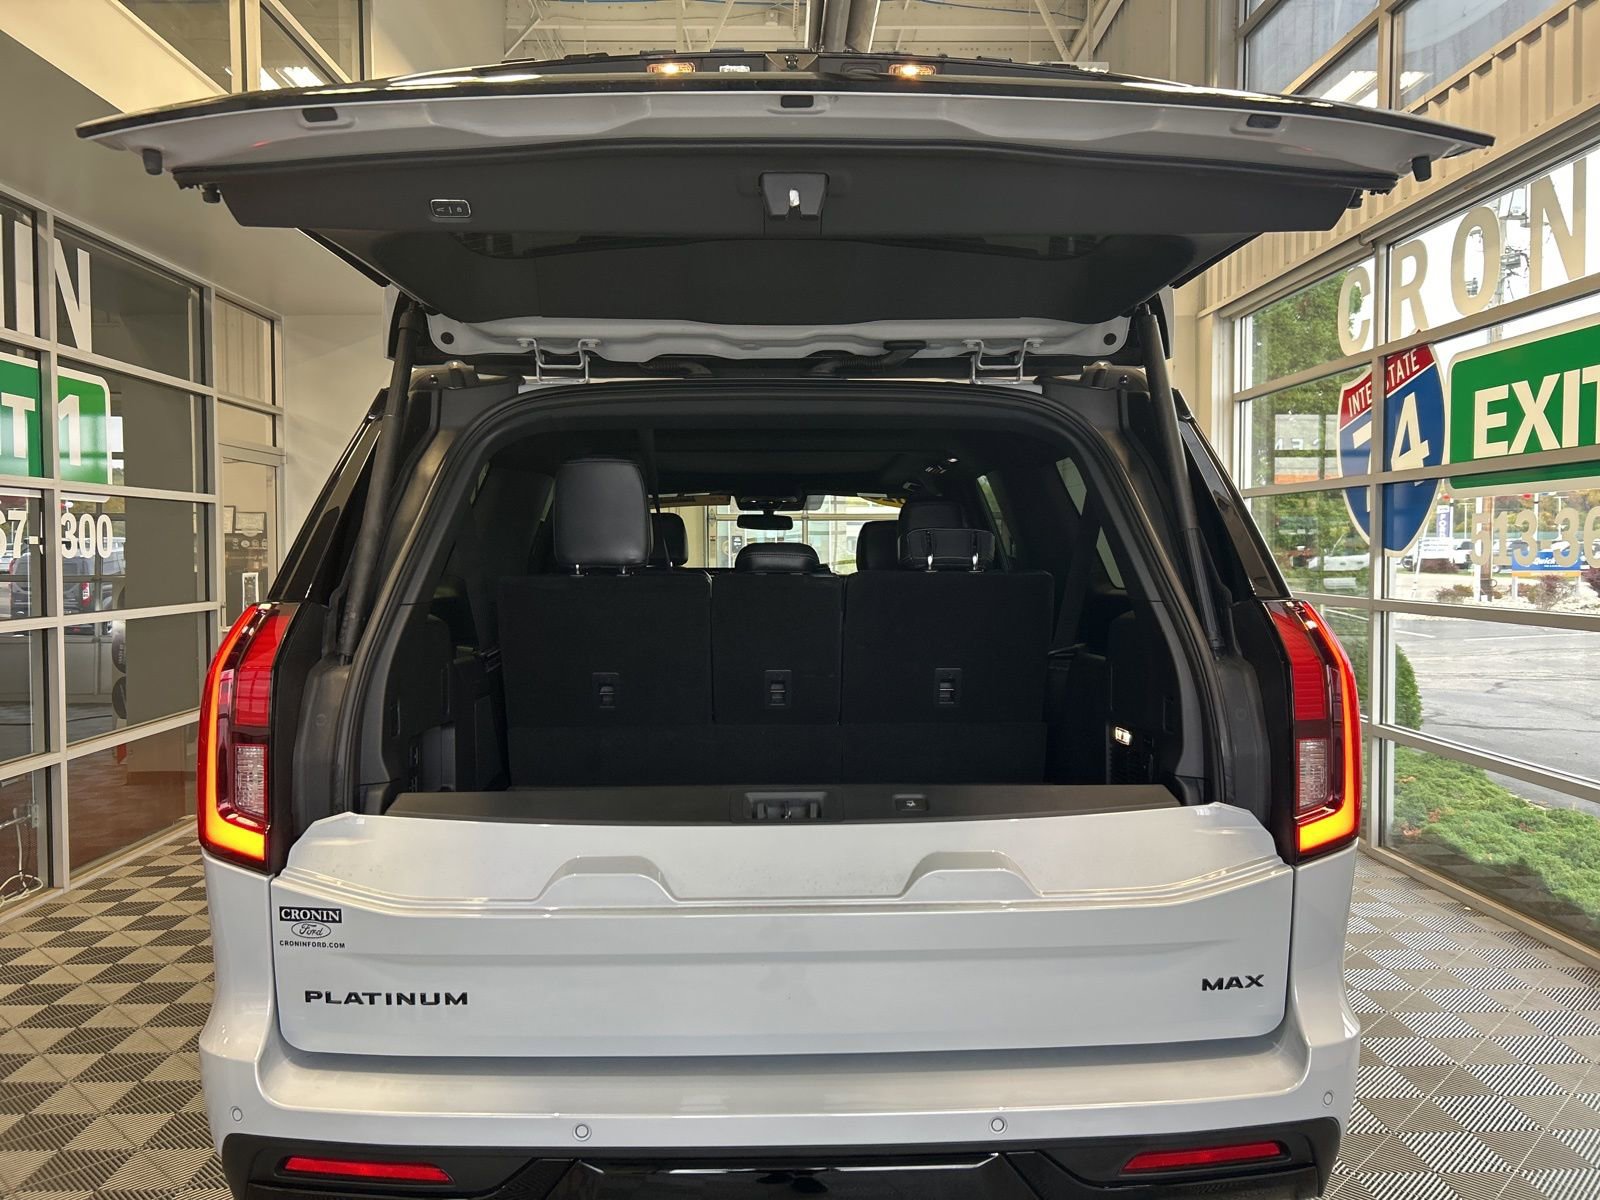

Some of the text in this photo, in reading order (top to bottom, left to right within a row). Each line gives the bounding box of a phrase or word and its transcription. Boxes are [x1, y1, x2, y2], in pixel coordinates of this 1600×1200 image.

[0, 214, 92, 353] IN
[1348, 349, 1420, 417] INTETATE
[281, 908, 341, 921] CRONIN
[299, 923, 324, 936] Ford
[279, 940, 346, 949] CRONINFORD.COM
[1201, 974, 1264, 991] MAX
[304, 990, 469, 1006] PLATINUM
